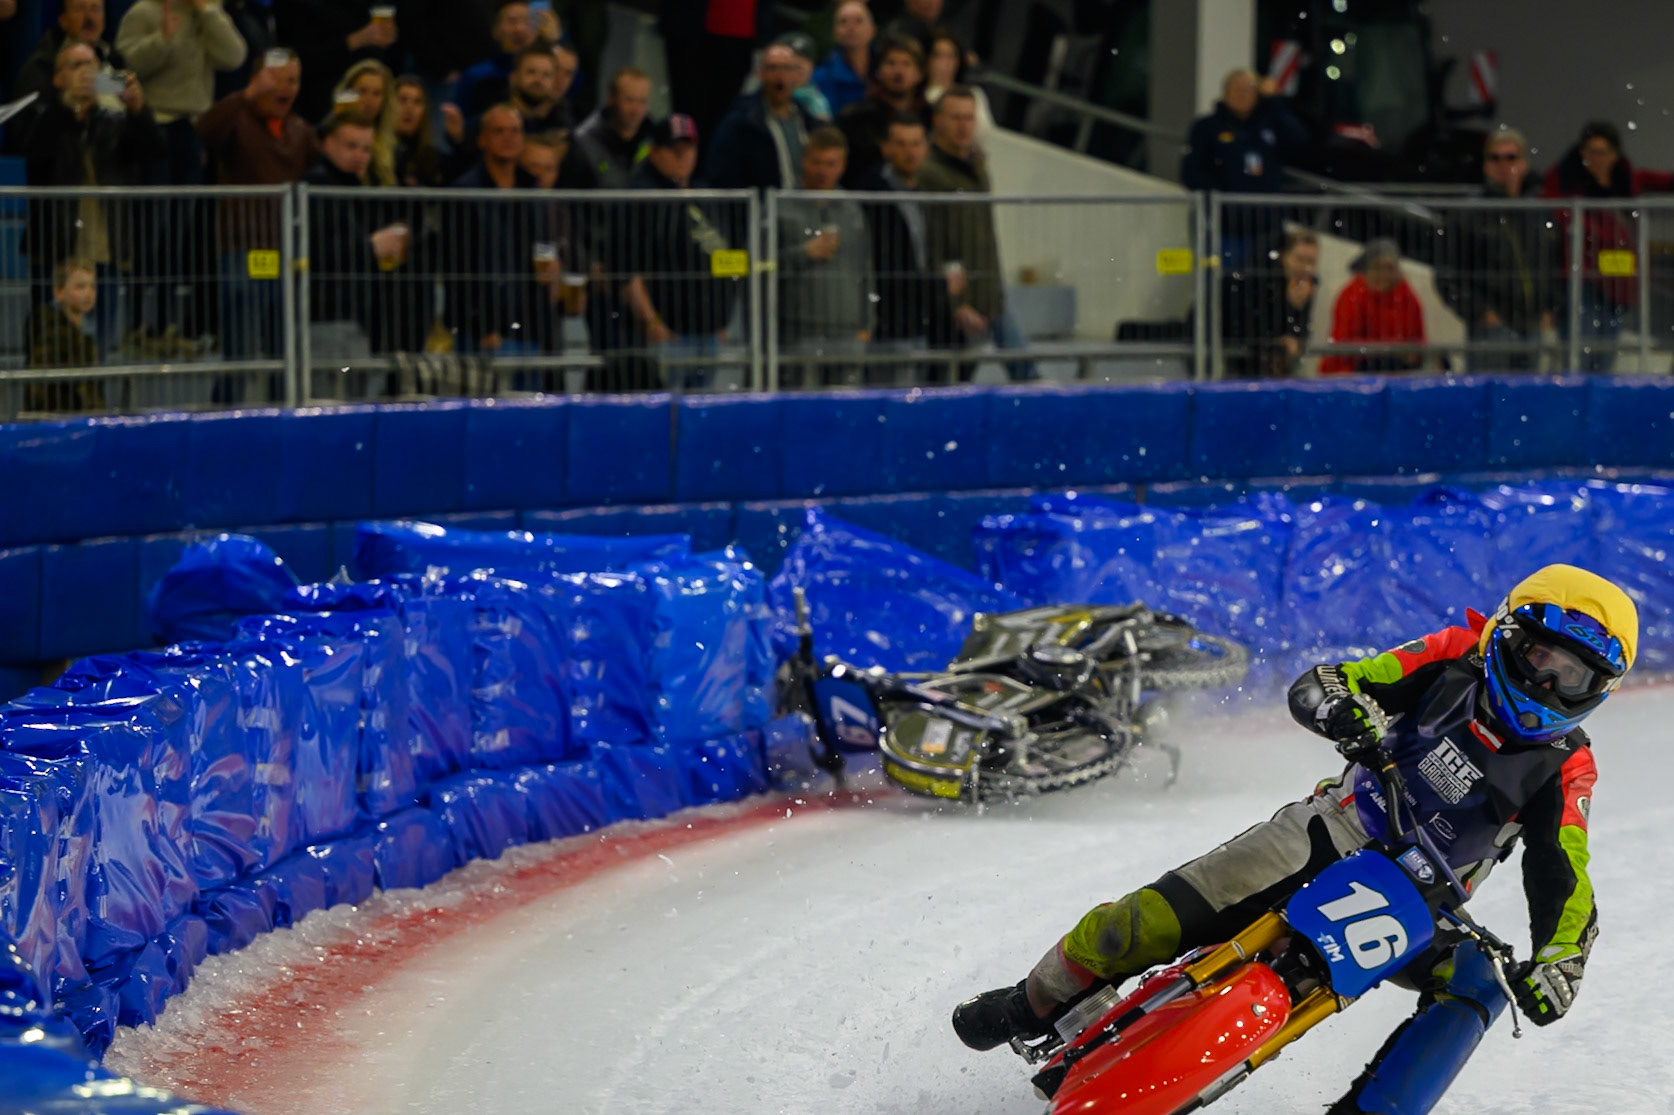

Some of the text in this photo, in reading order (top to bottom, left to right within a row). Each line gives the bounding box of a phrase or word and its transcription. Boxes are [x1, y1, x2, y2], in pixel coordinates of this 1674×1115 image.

[1417, 757, 1465, 804] GLADIATORS
[1432, 739, 1481, 789] ICE
[1316, 881, 1409, 970] 16
[1317, 933, 1345, 963] FIM
